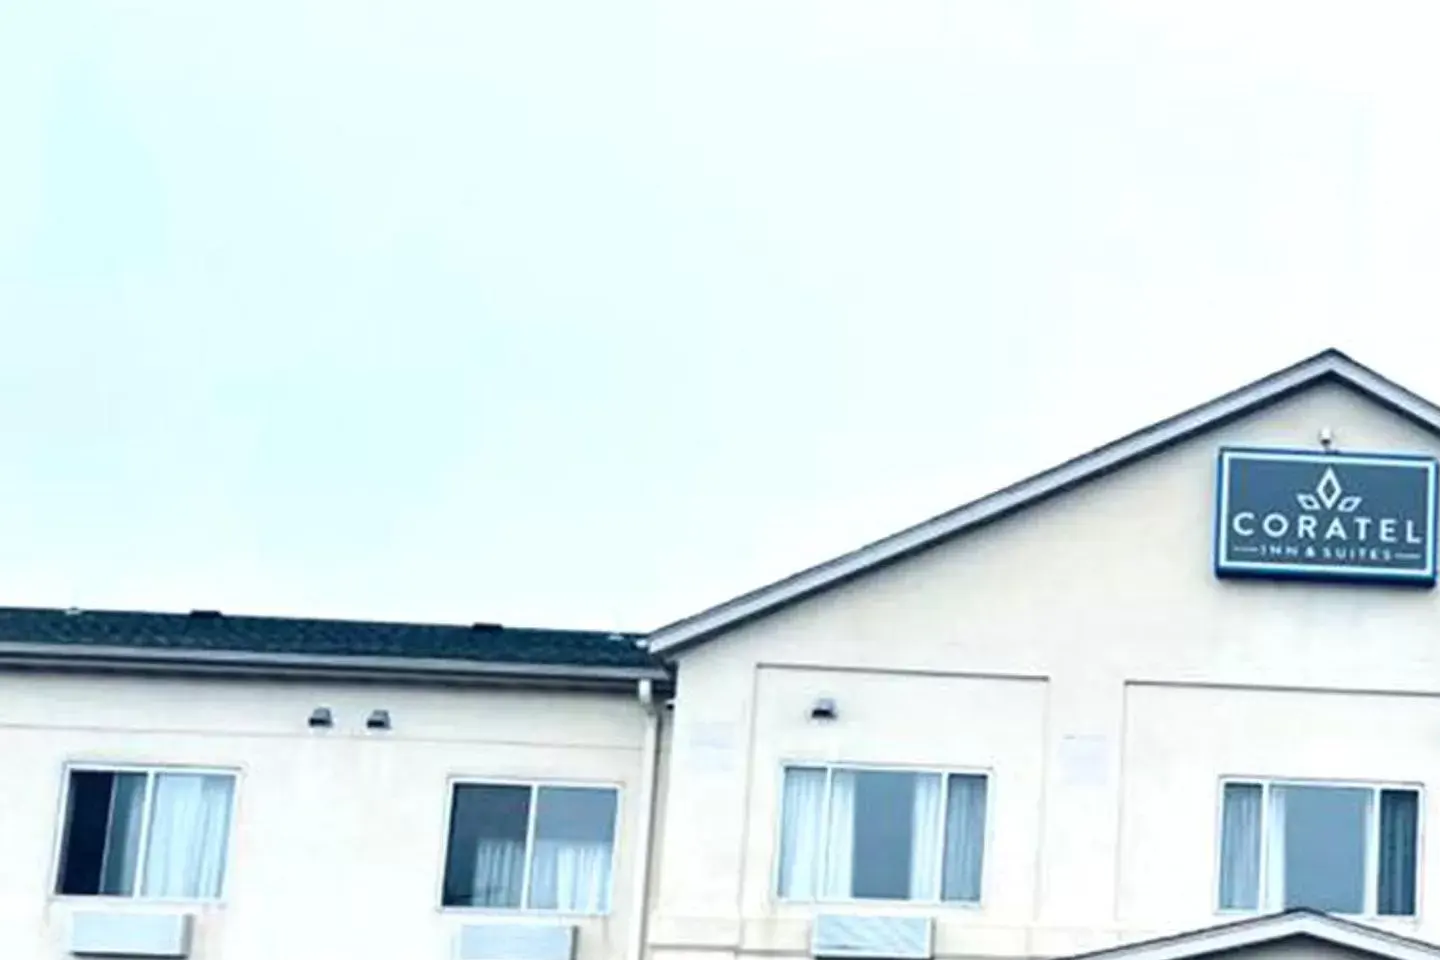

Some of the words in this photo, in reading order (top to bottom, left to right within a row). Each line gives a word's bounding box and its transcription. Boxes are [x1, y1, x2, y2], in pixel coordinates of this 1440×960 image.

[1232, 511, 1422, 544] CORATEL
[1259, 544, 1299, 556] INN
[1322, 546, 1392, 560] SUITES
